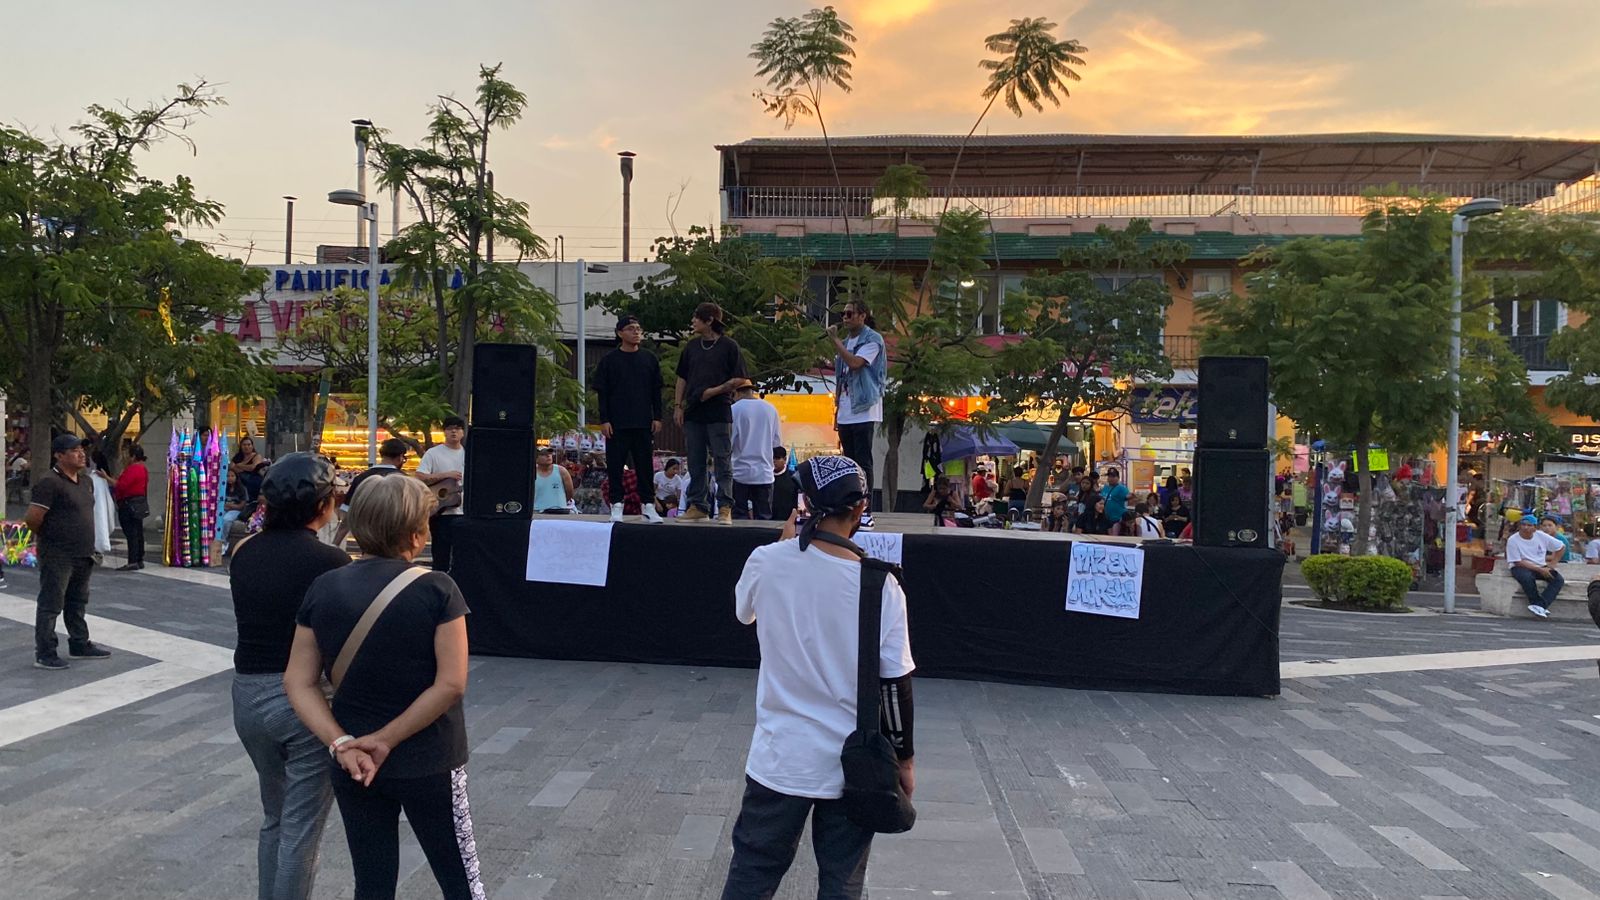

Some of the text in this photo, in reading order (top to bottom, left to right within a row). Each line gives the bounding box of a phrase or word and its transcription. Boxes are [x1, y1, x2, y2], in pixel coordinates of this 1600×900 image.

[275, 268, 464, 292] PANIFICAA
[1073, 544, 1138, 577] PAZ EN
